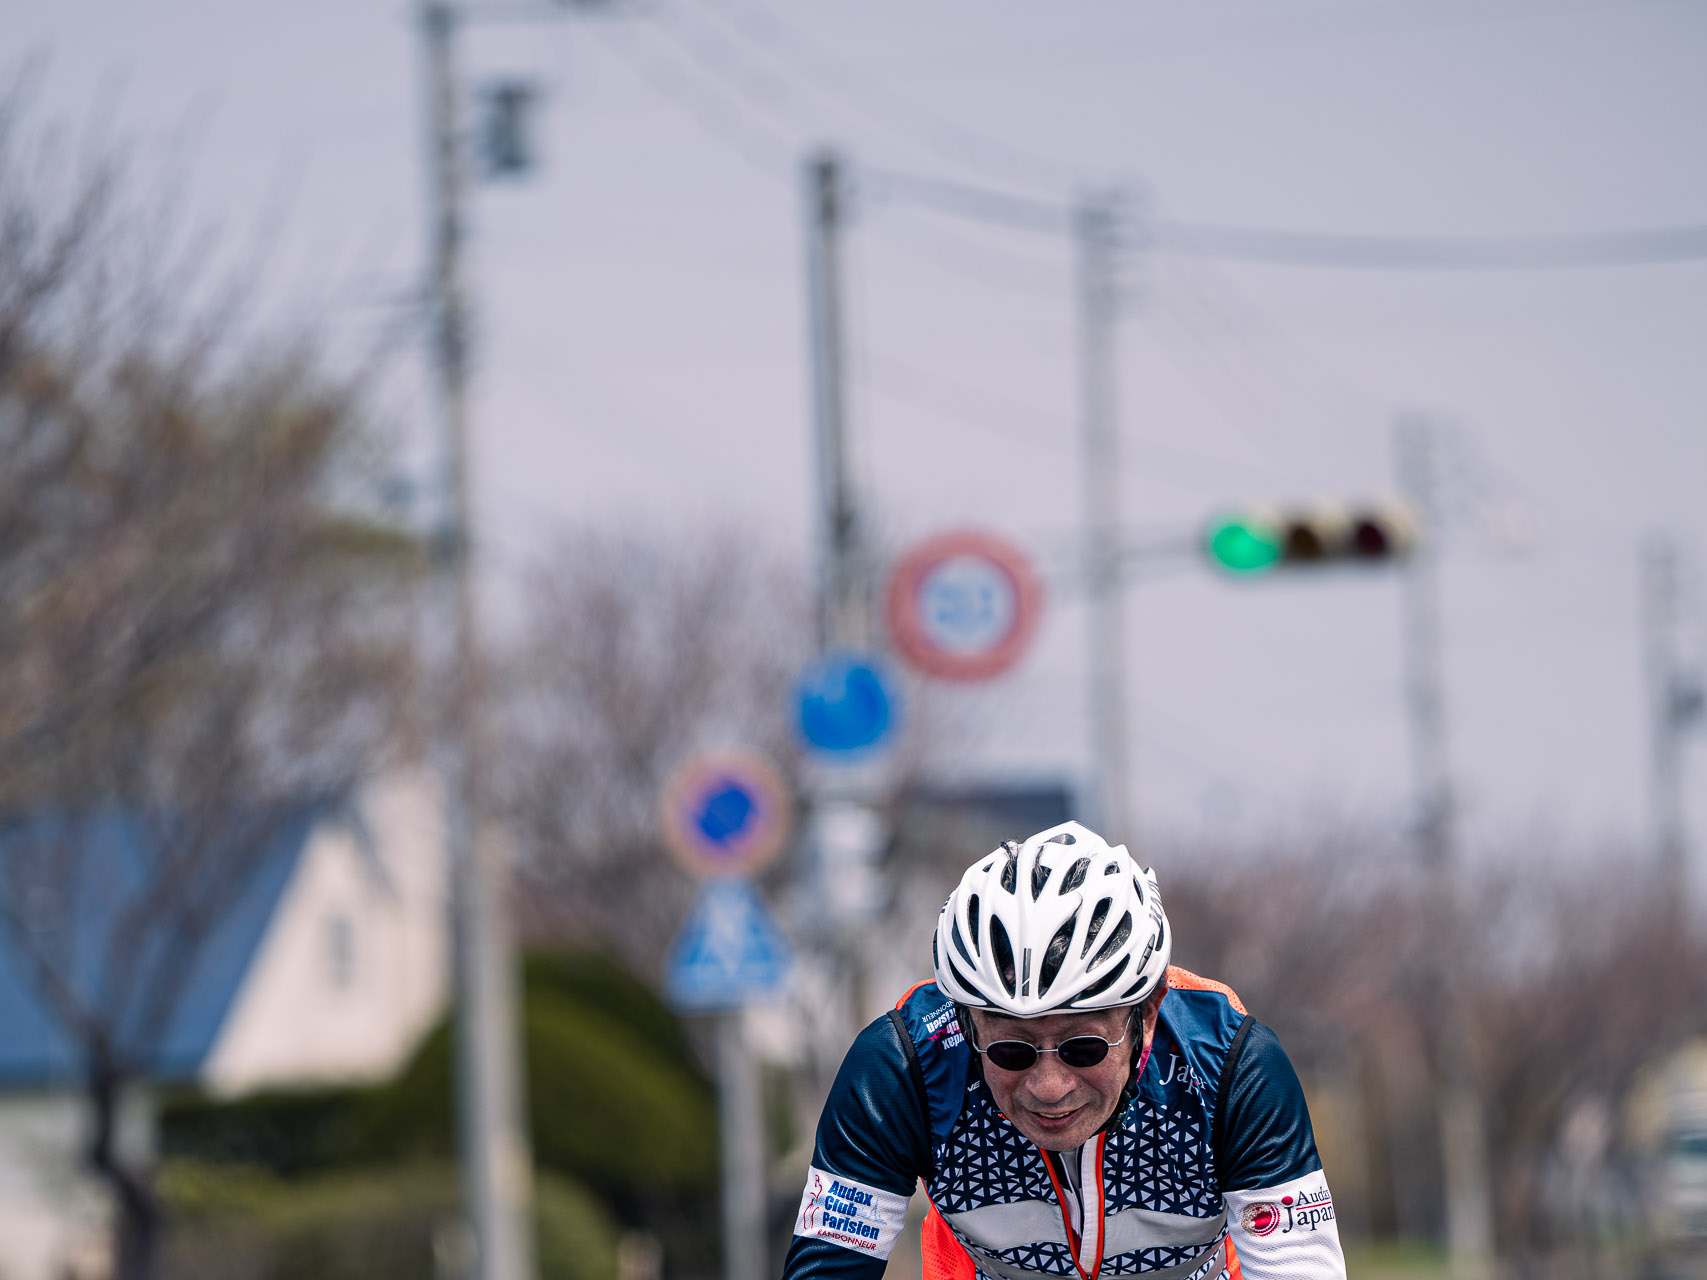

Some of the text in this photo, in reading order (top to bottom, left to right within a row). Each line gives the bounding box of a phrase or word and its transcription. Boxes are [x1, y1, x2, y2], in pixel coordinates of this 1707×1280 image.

[825, 1195, 858, 1217] Club
[828, 1180, 874, 1207] Audax
[822, 1211, 880, 1240] Parisien
[1282, 1204, 1335, 1234] Japan
[817, 1228, 877, 1251] RANDONNEUR
